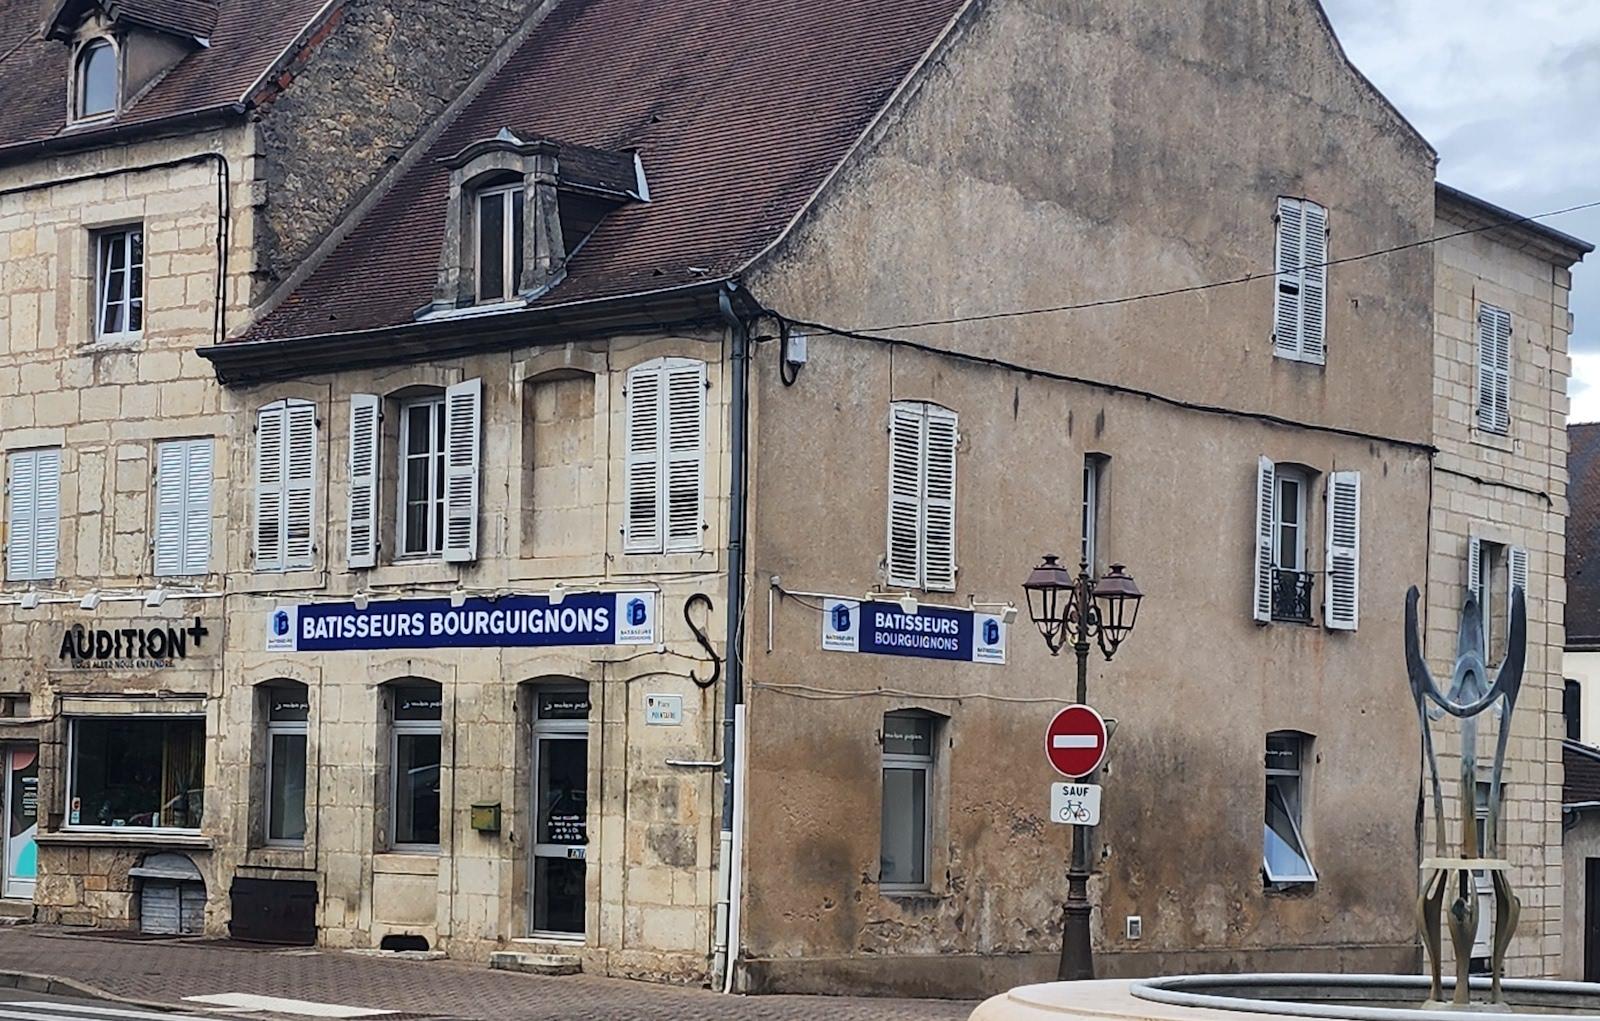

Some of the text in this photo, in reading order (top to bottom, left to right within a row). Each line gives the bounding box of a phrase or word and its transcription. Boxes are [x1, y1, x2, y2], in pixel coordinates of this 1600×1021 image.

[303, 607, 609, 639] BATISSEURS BOURGUIGNONS
[875, 612, 959, 634] BATISSEURS
[875, 632, 959, 651] BOURGUIGNONS
[92, 660, 113, 669] ALLEZ
[114, 659, 134, 669] NOUS
[1062, 785, 1089, 797] SAUF
